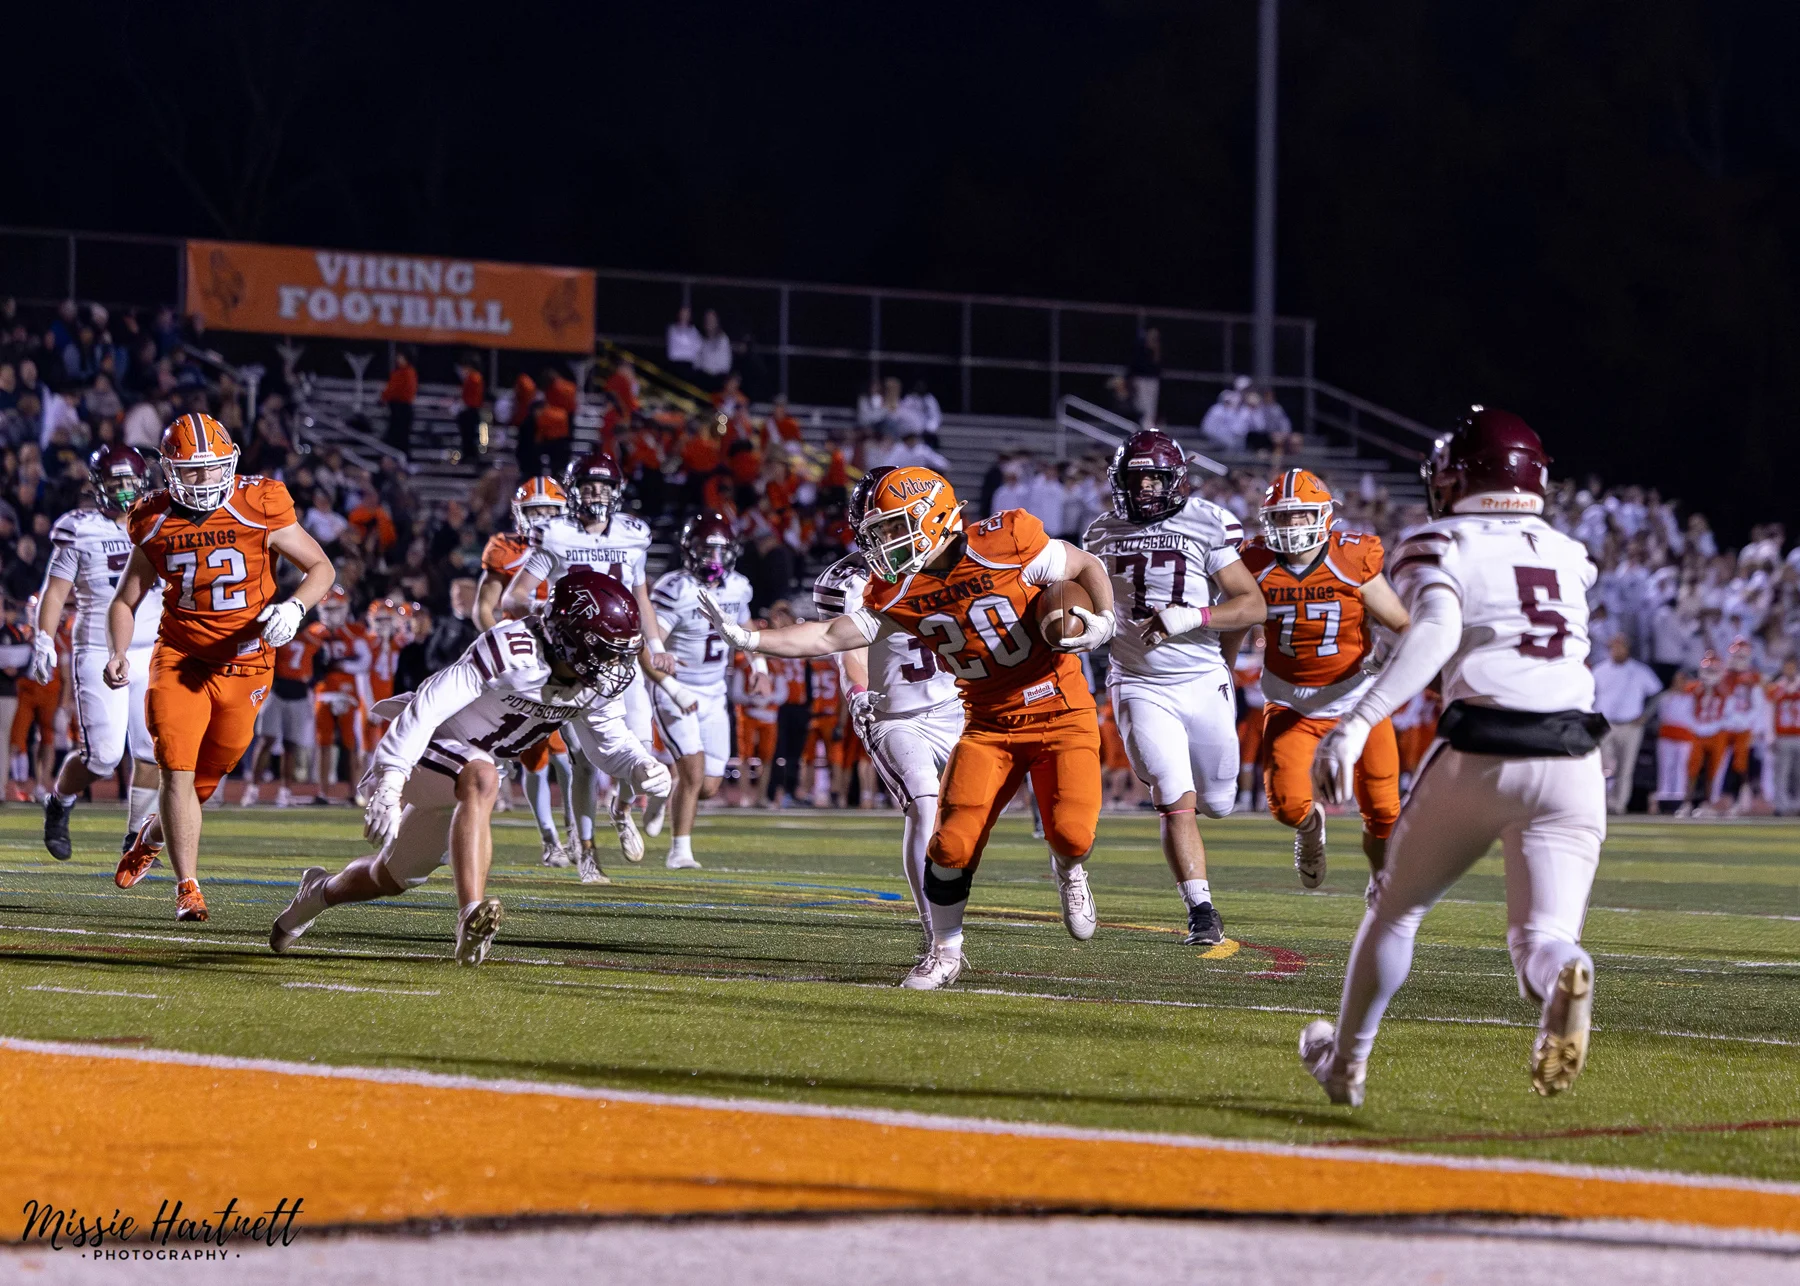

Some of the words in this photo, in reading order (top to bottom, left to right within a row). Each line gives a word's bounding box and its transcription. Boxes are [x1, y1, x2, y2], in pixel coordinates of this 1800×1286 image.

[314, 251, 475, 294] VIKING
[278, 285, 512, 335] FOOTBALL
[888, 477, 946, 501] Vikin
[1481, 498, 1536, 509] Riddell
[164, 529, 237, 550] VIKINGS
[566, 548, 627, 563] POTTSGROVE
[1115, 534, 1190, 553] POTTSGROVE
[165, 547, 248, 612] 72
[907, 573, 994, 613] VIKINGS
[1115, 550, 1188, 620] 77
[1268, 586, 1335, 602] VIKINGS
[1266, 600, 1341, 658] 77
[1513, 566, 1571, 659] 5
[504, 631, 535, 656] 10
[918, 594, 1032, 680] 20
[900, 637, 946, 683] 3
[501, 695, 584, 720] POTTSGROVE
[1027, 685, 1051, 697] Riddell
[467, 711, 563, 759] 10
